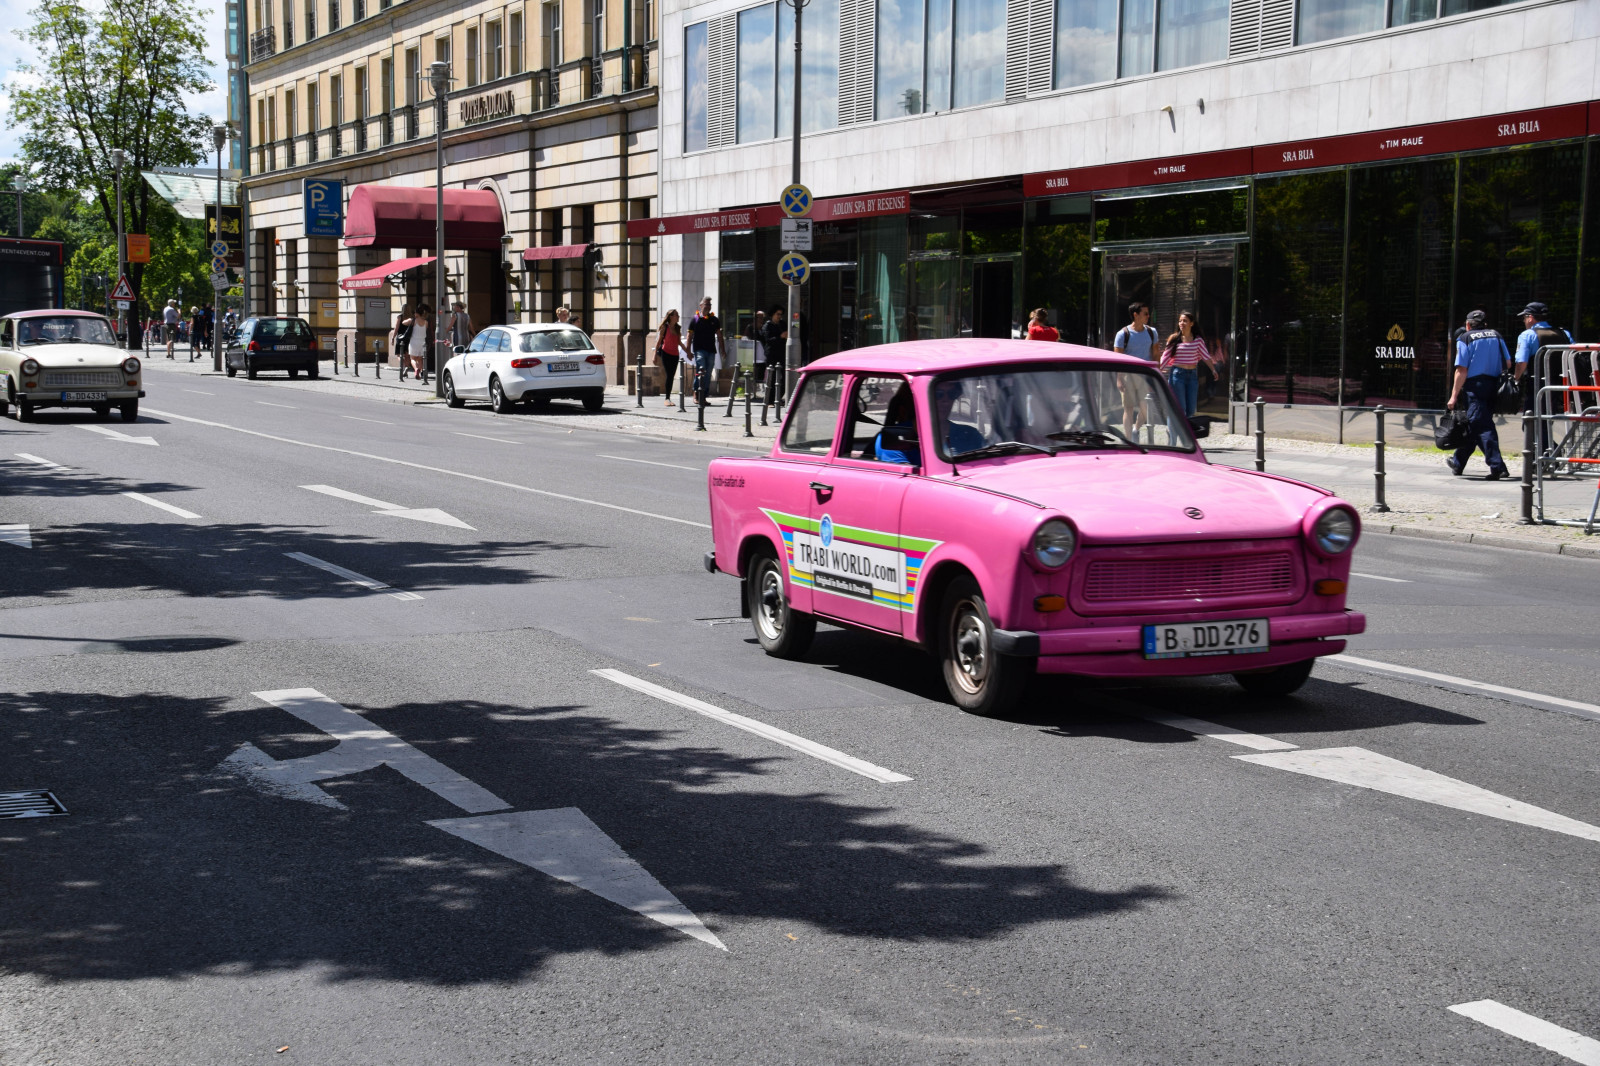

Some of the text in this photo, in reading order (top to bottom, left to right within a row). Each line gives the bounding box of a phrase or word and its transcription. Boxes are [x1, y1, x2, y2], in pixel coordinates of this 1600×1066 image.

[1497, 120, 1540, 137] SRA BUA
[1385, 139, 1399, 148] TIM
[1401, 136, 1424, 146] RAUE
[1282, 149, 1314, 163] SRA BUA
[1158, 167, 1169, 175] TIM
[1169, 164, 1186, 173] RAUE
[1045, 177, 1069, 189] SRA BUA
[311, 189, 325, 209] P
[831, 196, 906, 215] ADLON SPA BY RESENSE
[694, 213, 750, 229] ADLON SPA BY RESENSE
[1375, 346, 1415, 359] SRA BUA
[800, 543, 897, 583] TRABI WORLD.com
[1164, 628, 1178, 650] B
